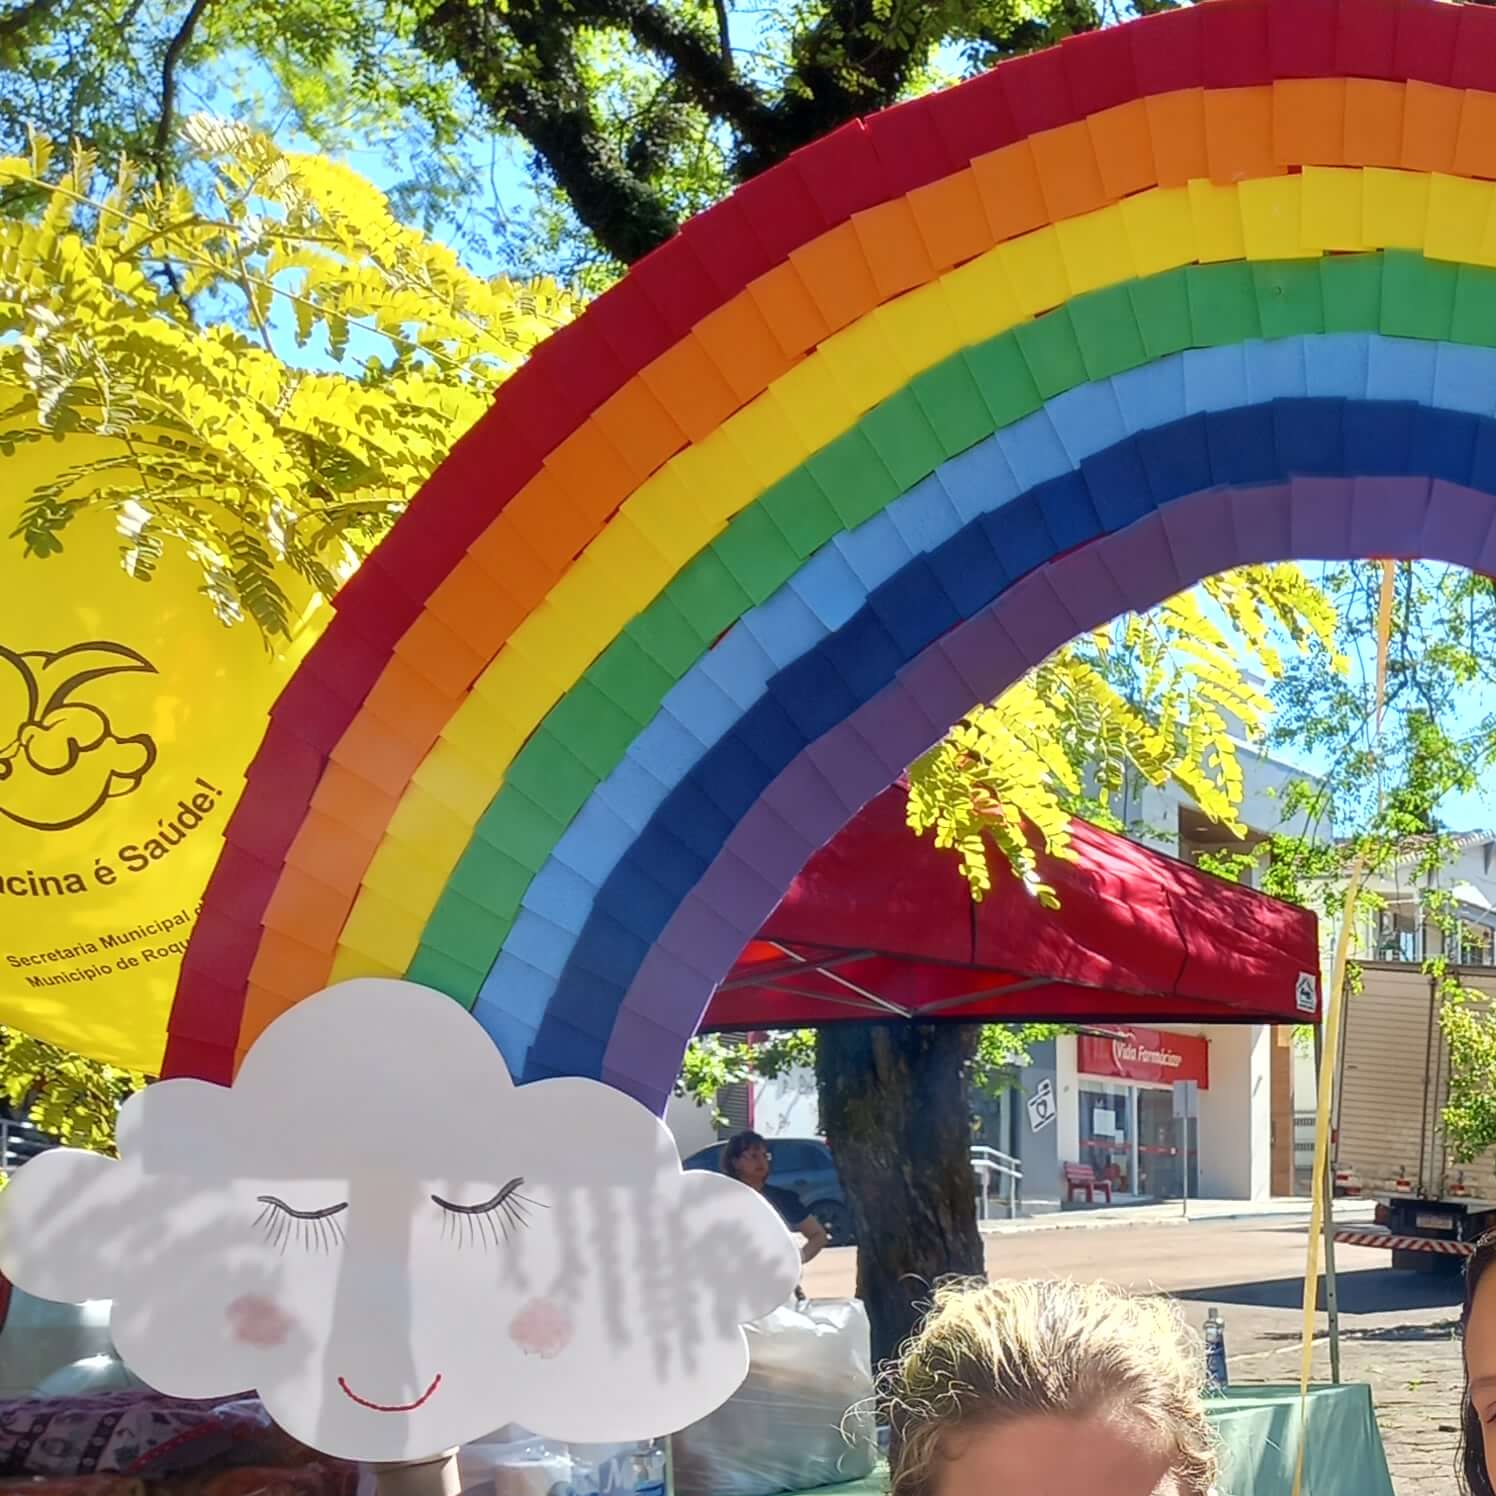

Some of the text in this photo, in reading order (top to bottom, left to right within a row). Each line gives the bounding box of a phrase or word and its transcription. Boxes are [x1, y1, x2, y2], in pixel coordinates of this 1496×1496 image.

[94, 858, 117, 885] é
[118, 777, 223, 872] Saúde!
[6, 942, 98, 968] Secretaria
[99, 909, 191, 949] Municipal
[117, 956, 139, 970] de
[1117, 1042, 1137, 1060] Vida
